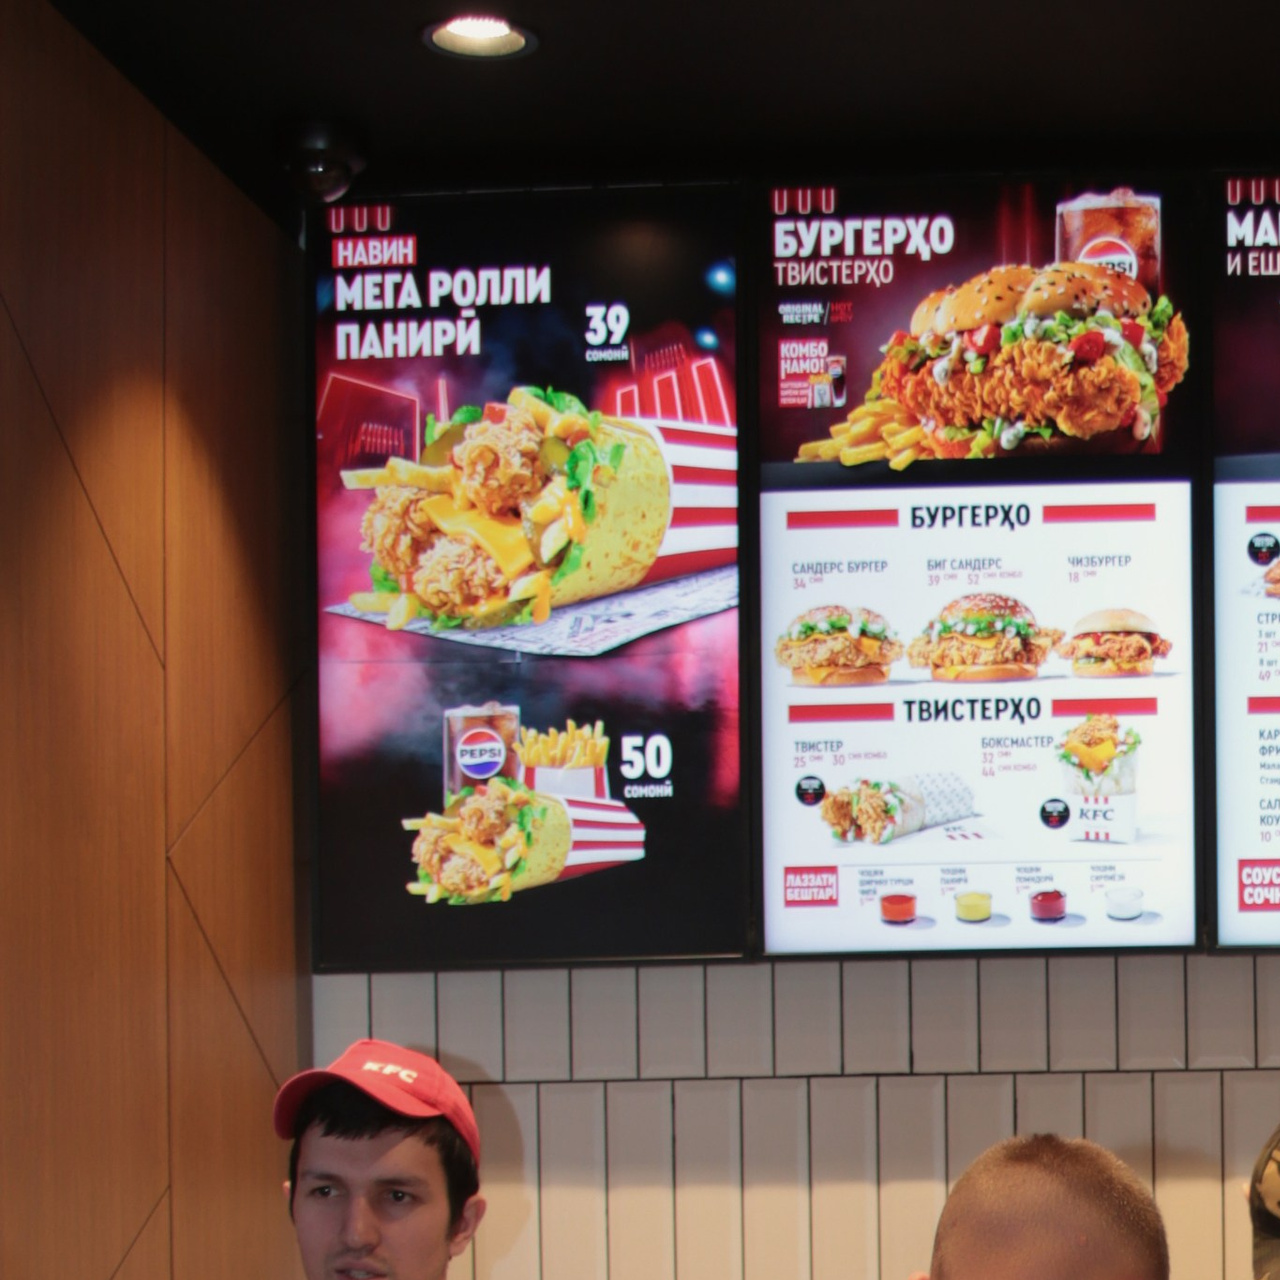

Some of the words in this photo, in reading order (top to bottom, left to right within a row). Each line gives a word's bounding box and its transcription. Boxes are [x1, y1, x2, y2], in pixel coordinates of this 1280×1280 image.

[774, 216, 954, 260] БУРГЕРҲО
[338, 237, 413, 266] НАВИН
[1227, 252, 1241, 276] И
[774, 259, 893, 288] ТВИСТЕРҲО
[336, 271, 422, 311] МЕГА
[429, 266, 551, 308] РОЛЛИ
[585, 304, 630, 346] 39
[780, 342, 828, 358] КОМБО
[911, 504, 1031, 531] БУРГЕРҲО
[792, 562, 844, 575] САНДЕРС
[847, 560, 888, 573] БУРГЕР
[927, 559, 947, 572] БИГ
[949, 557, 1002, 571] САНДЕРС
[1067, 555, 1132, 568] ЧИЗБУРГЕР
[793, 577, 807, 590] 34
[928, 575, 940, 586] 39
[967, 573, 980, 585] 52
[1068, 571, 1080, 583] 18
[1258, 641, 1269, 653] 21
[1258, 670, 1271, 681] 49
[903, 698, 1041, 724] ТВИСТЕРҲО
[794, 740, 843, 753] ТВИСТЕР
[981, 736, 1054, 749] БОКСМАСТЕР
[460, 748, 502, 759] PEPSI
[620, 733, 673, 780] 50
[982, 752, 994, 763] 32
[793, 756, 806, 768] 25
[832, 754, 845, 766] 30
[982, 767, 995, 778] 44
[1079, 808, 1114, 821] KFC
[1260, 831, 1271, 842] 10
[362, 1061, 418, 1084] KFC
